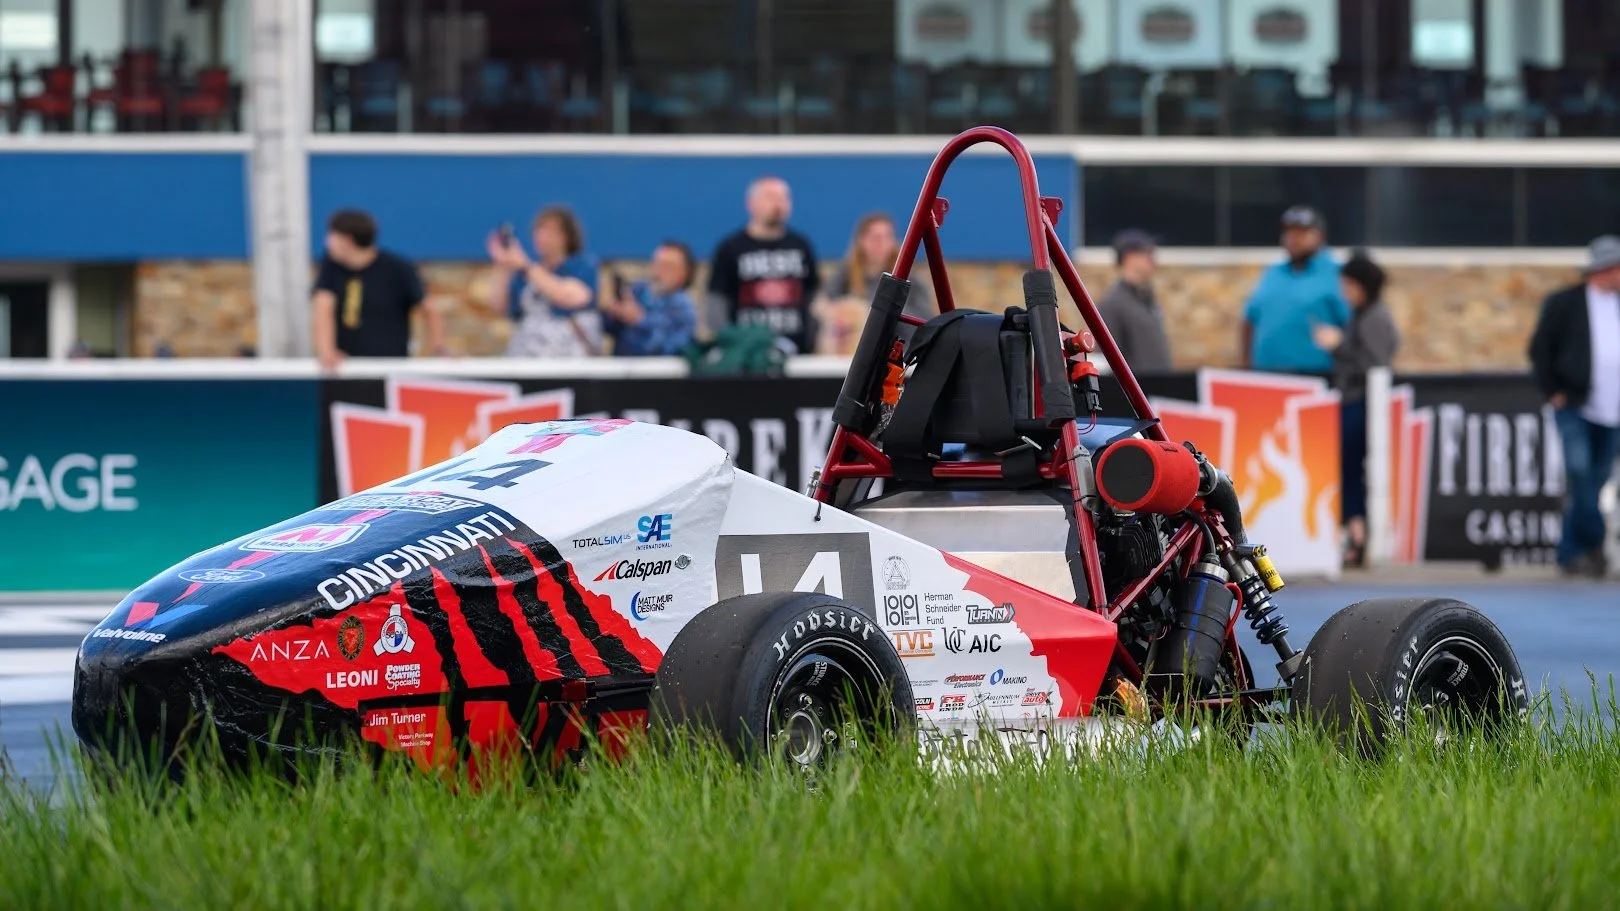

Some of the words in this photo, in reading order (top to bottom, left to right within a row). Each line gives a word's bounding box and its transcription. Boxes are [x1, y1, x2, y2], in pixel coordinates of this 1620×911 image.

[0, 452, 140, 513] AGE
[637, 514, 673, 543] SAE
[573, 536, 622, 549] TOTALSIM
[636, 543, 672, 552] INTERNATIONAL
[317, 511, 516, 611] CINCINNATI
[616, 559, 672, 581] Calspan
[638, 595, 656, 606] MATT
[657, 594, 673, 603] MUIR
[924, 592, 954, 602] Herman
[637, 602, 665, 613] DESIGNS
[925, 604, 962, 613] Schneider
[926, 615, 945, 625] Fund
[93, 628, 167, 643] Valvoline
[773, 610, 875, 663] Hoosier
[893, 630, 933, 652] TVC
[968, 633, 1001, 653] AIC
[250, 640, 330, 661] ANZA
[385, 671, 420, 681] COATING
[387, 664, 420, 674] POWDER
[326, 670, 379, 689] LEONI
[1002, 676, 1028, 685] MAKINO
[369, 713, 389, 727] Jim
[391, 712, 426, 725] Turner
